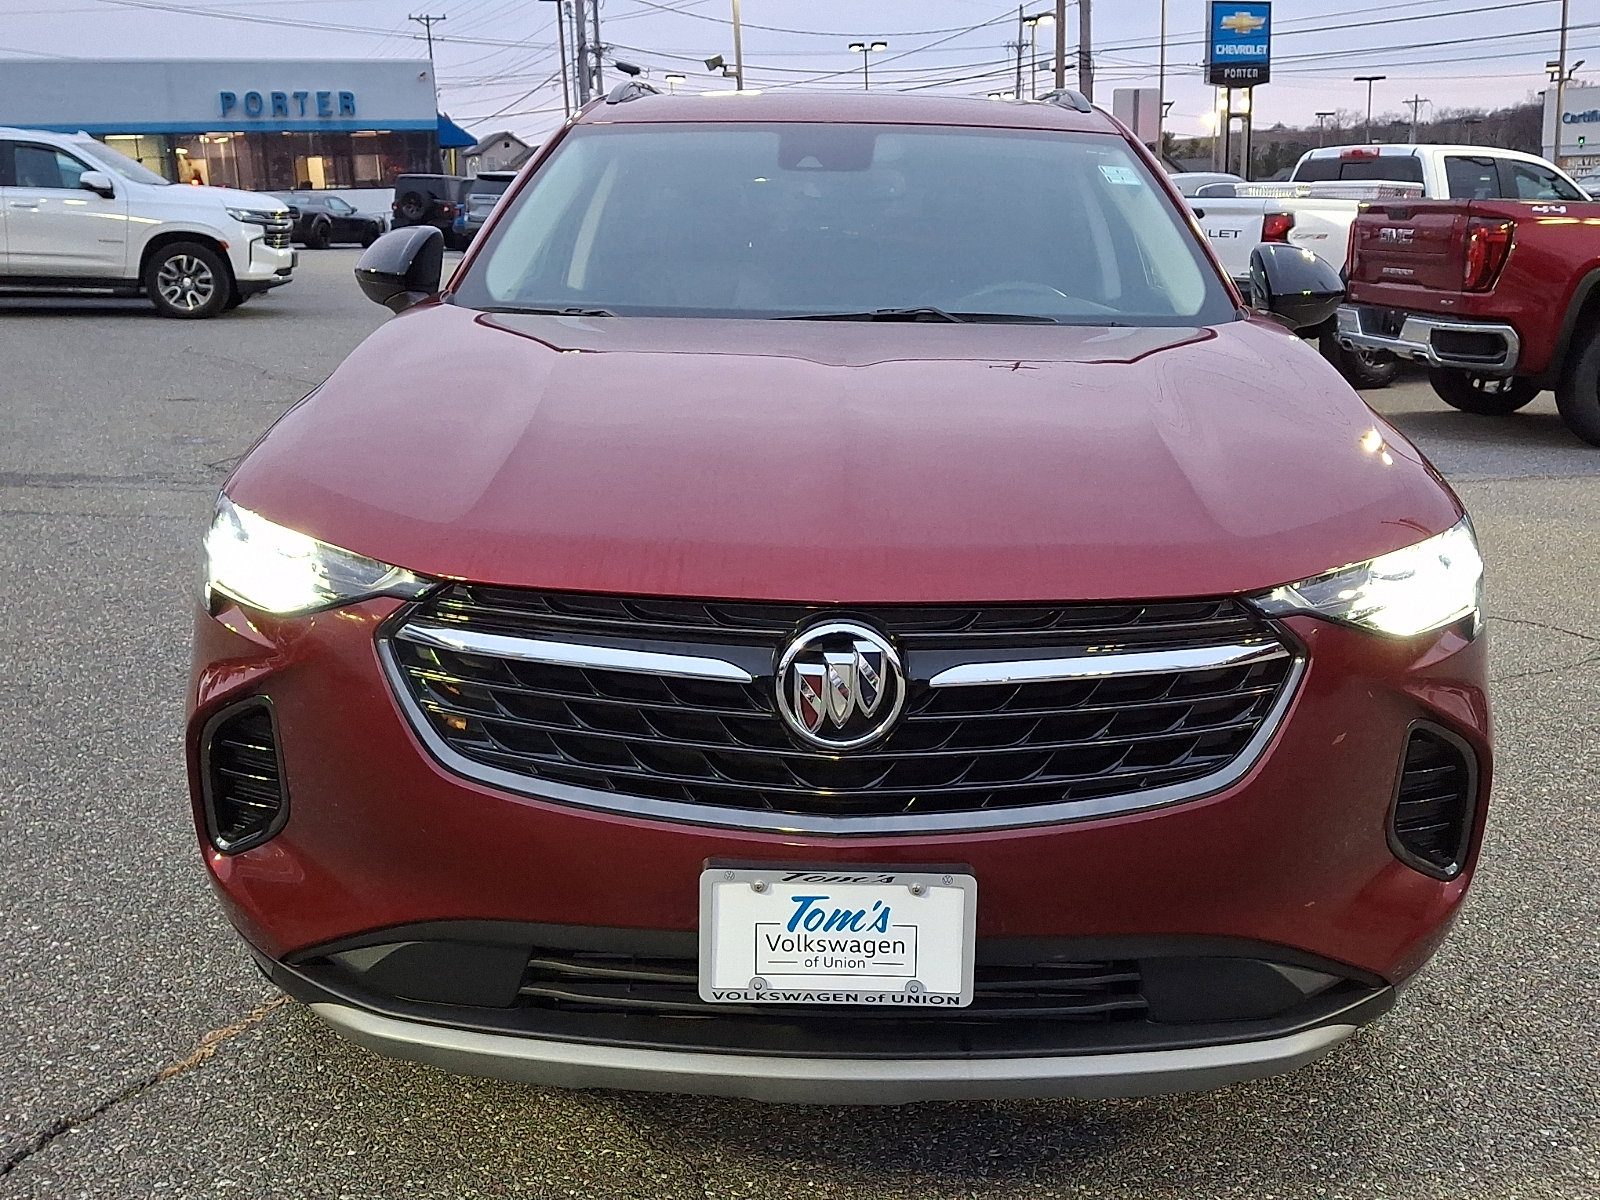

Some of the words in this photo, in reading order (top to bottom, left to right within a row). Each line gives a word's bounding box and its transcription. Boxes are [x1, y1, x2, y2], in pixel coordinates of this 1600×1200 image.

[1215, 44, 1268, 55] CHEVROLET
[1224, 68, 1259, 78] PORTER
[220, 91, 356, 117] PORTER
[1208, 229, 1243, 238] LET
[781, 872, 896, 884] Tom's
[786, 896, 891, 933] Tom's
[765, 933, 906, 958] Volkswagen
[804, 956, 819, 968] of
[823, 956, 866, 969] Union
[711, 991, 859, 1003] VOLKSWAGEN
[865, 993, 886, 1003] of
[891, 993, 960, 1005] UNION
